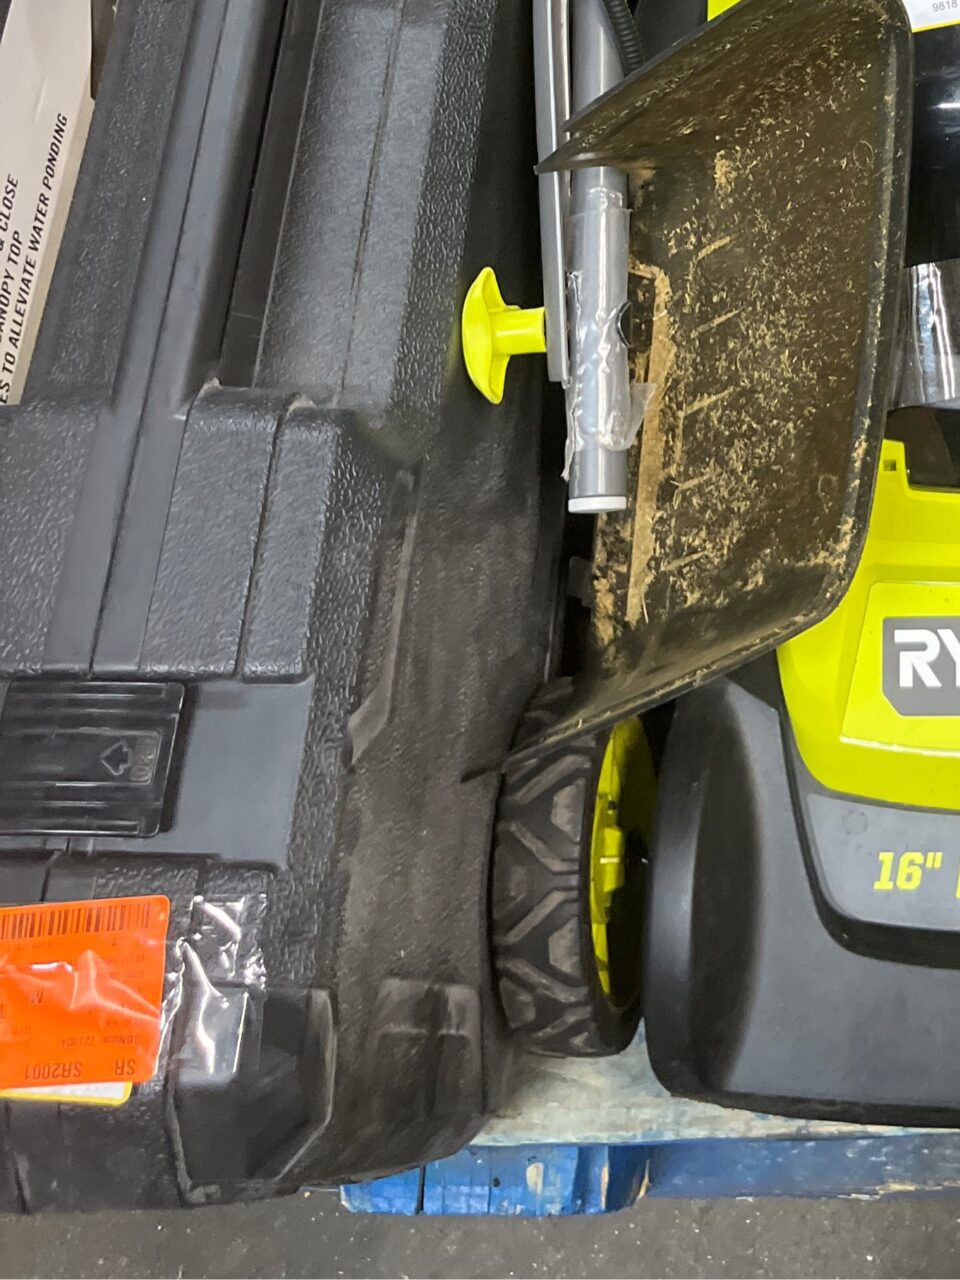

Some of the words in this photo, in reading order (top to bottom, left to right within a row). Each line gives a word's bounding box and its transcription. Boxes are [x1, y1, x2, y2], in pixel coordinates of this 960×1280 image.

[42, 112, 68, 191] PONDING
[0, 173, 19, 233] CLOSE
[28, 192, 50, 252] WATER
[7, 230, 23, 265] TOP
[0, 268, 15, 343] NOPY
[8, 254, 37, 349] ALLEVIATE
[2, 352, 16, 375] TO
[873, 851, 943, 892] 16"
[24, 1060, 83, 1080] SR2001
[114, 1059, 136, 1076] SR
